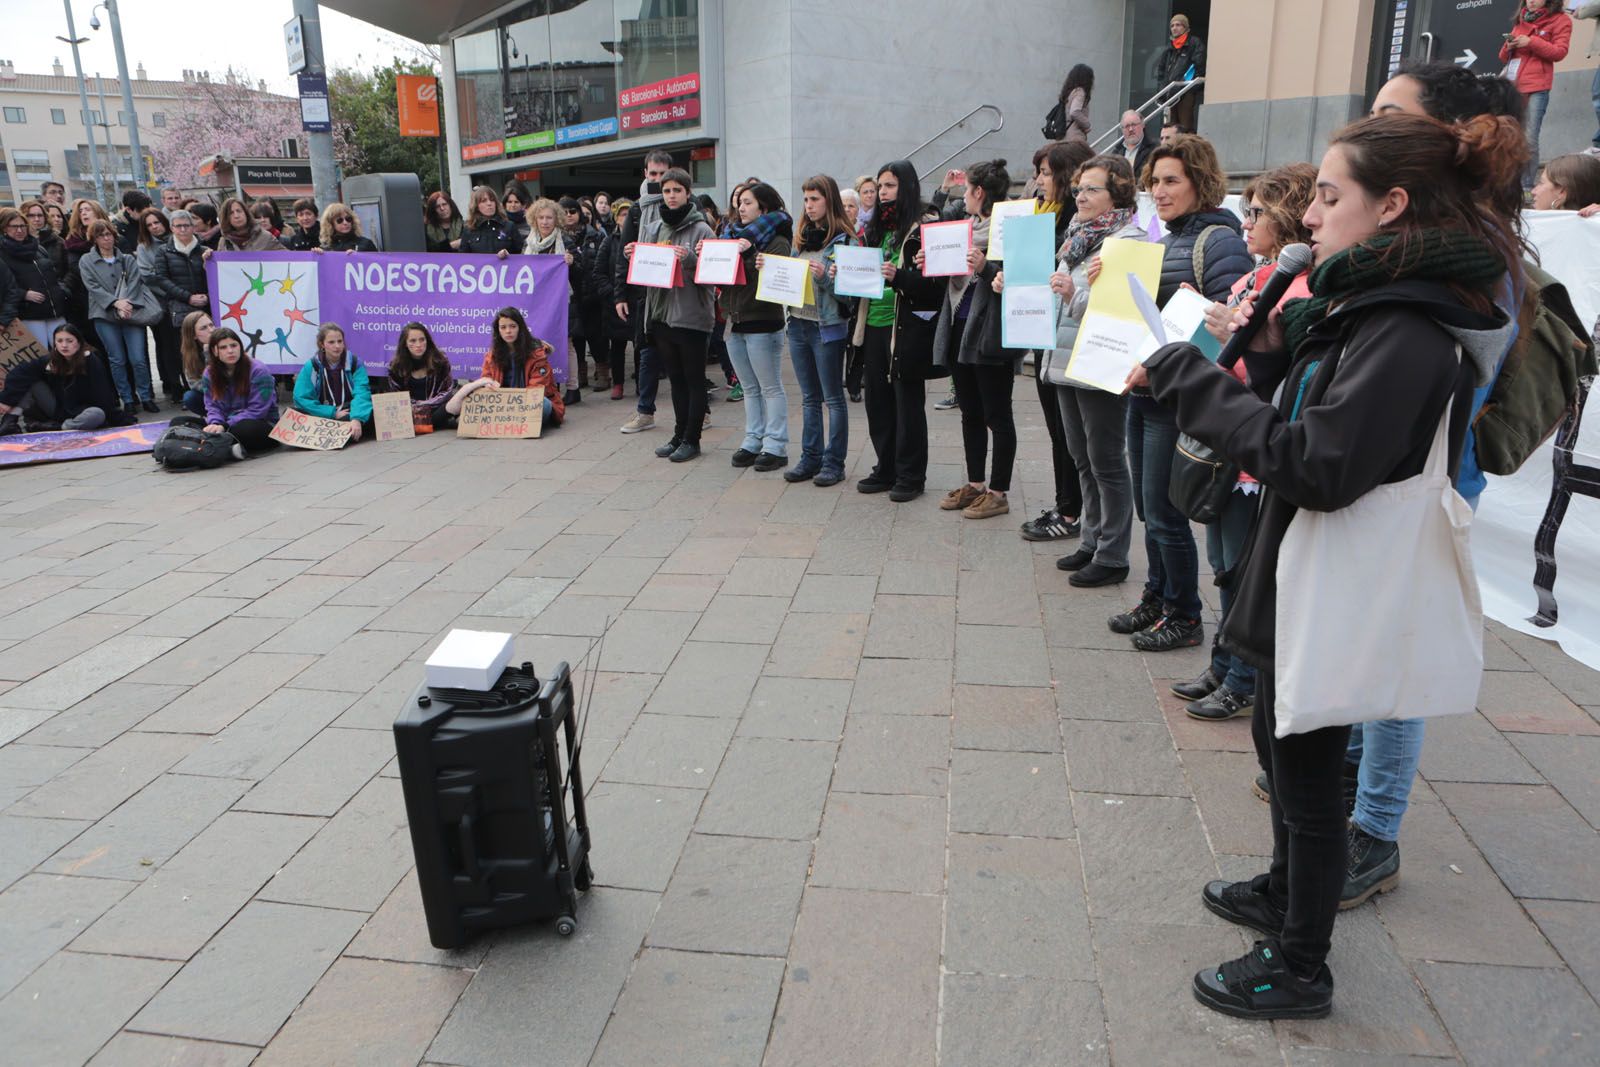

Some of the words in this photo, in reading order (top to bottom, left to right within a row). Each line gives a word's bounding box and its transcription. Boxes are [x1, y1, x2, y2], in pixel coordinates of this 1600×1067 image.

[621, 93, 629, 106] S6
[666, 79, 696, 95] Autònoma
[622, 116, 630, 128] S7
[640, 109, 668, 124] Barcelona
[672, 103, 687, 118] Rubí
[247, 170, 263, 178] Plaça
[344, 262, 535, 295] NOESTASOLA
[355, 303, 410, 316] Associació
[411, 304, 425, 316] de
[427, 304, 460, 317] dones
[352, 321, 366, 331] en
[367, 320, 401, 332] contra
[430, 321, 475, 334] violència
[477, 322, 492, 335] de
[464, 393, 503, 404] SOMOS
[507, 394, 524, 405] LAS
[464, 403, 495, 415] NIETAS
[285, 411, 308, 426] NO
[314, 418, 344, 429] SOY
[463, 414, 480, 425] QUE
[291, 422, 311, 433] UN
[480, 422, 529, 437] QUEMAR
[271, 426, 296, 442] NO
[295, 434, 313, 447] ME
